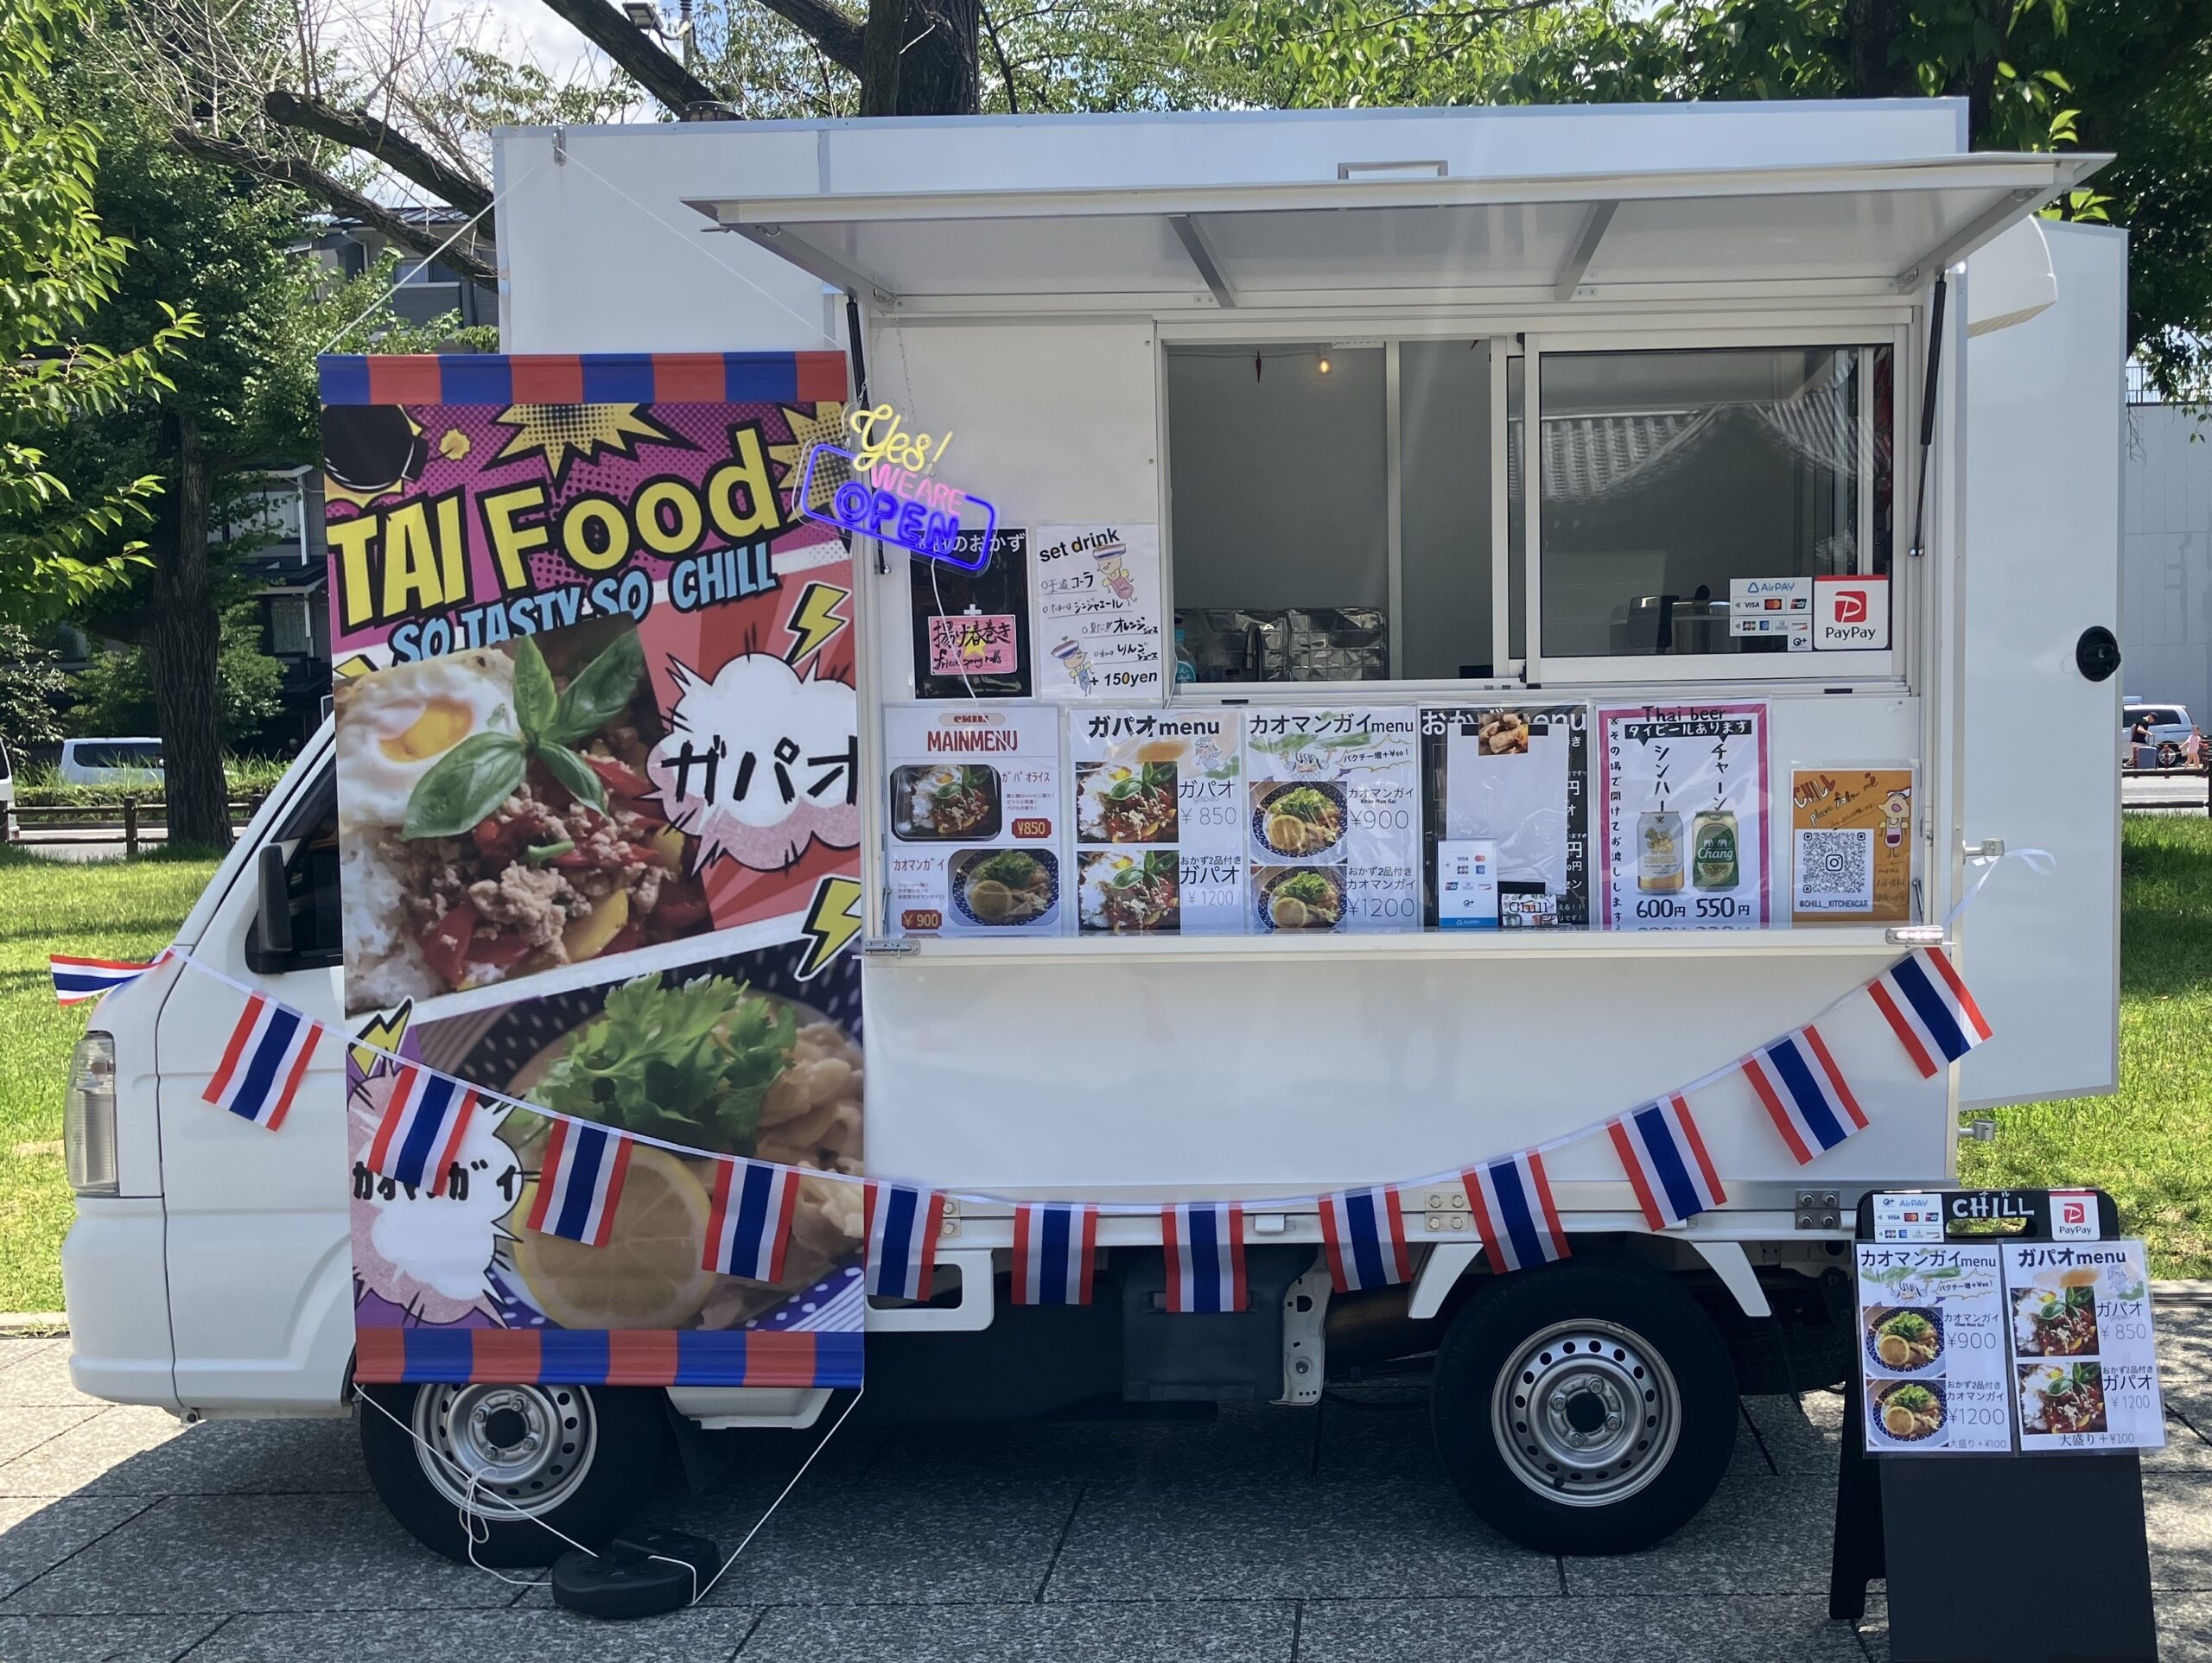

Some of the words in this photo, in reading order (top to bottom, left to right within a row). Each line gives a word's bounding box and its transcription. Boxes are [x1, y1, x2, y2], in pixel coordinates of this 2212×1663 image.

[850, 403, 953, 475] Yes!
[834, 480, 959, 555] OPEN
[326, 498, 467, 628] TAI
[484, 427, 778, 591] Food
[1039, 541, 1069, 562] set
[1071, 527, 1120, 553] drink
[1760, 581, 1796, 592] AirPAY
[392, 617, 451, 666] SO
[461, 586, 581, 649] TASTY
[592, 569, 649, 621] SO
[672, 542, 777, 609] CHILL
[932, 619, 1011, 649] 揚げ春巻き
[1826, 626, 1877, 641] PayPay
[1642, 706, 1681, 723] Thai
[1690, 707, 1727, 720] beer
[1089, 715, 1220, 738] ガパオmenu
[1249, 714, 1414, 735] カオマンガイmenu
[1629, 720, 1747, 738] タイビールあります
[1654, 745, 1670, 812] シンハー
[1711, 743, 1729, 811] チャーン
[1179, 779, 1236, 798] ガパオ
[1348, 787, 1414, 798] カオマンガイ
[1350, 809, 1409, 829] ¥900
[1017, 822, 1046, 835] ¥850
[1180, 855, 1242, 866] おかず2品付き
[1698, 847, 1733, 861] Chang
[893, 858, 945, 872] カオマンガイ
[1349, 866, 1412, 877] おかず2品付き
[1179, 865, 1240, 885] ガパオ
[1347, 879, 1416, 891] カオマンガイ
[1348, 898, 1414, 917] ¥1200
[1636, 898, 1686, 918] 600円
[1695, 897, 1750, 918] 550円
[1952, 1196, 2035, 1219] CHILL
[2059, 1226, 2092, 1235] PayPay
[1860, 1249, 1997, 1268] カオマンガイmenu
[2018, 1248, 2126, 1267] ガパオmenu
[1944, 1312, 1999, 1323] カオマンガイ
[2096, 1301, 2143, 1317] ガパオ
[1946, 1331, 1997, 1349] ¥900
[2102, 1365, 2153, 1374] おかず2品付き
[1948, 1381, 2001, 1390] おかず2品付き
[2103, 1374, 2152, 1391] ガパオ
[1946, 1391, 2005, 1402] カオマンガイ
[1948, 1408, 2005, 1425] ¥1200
